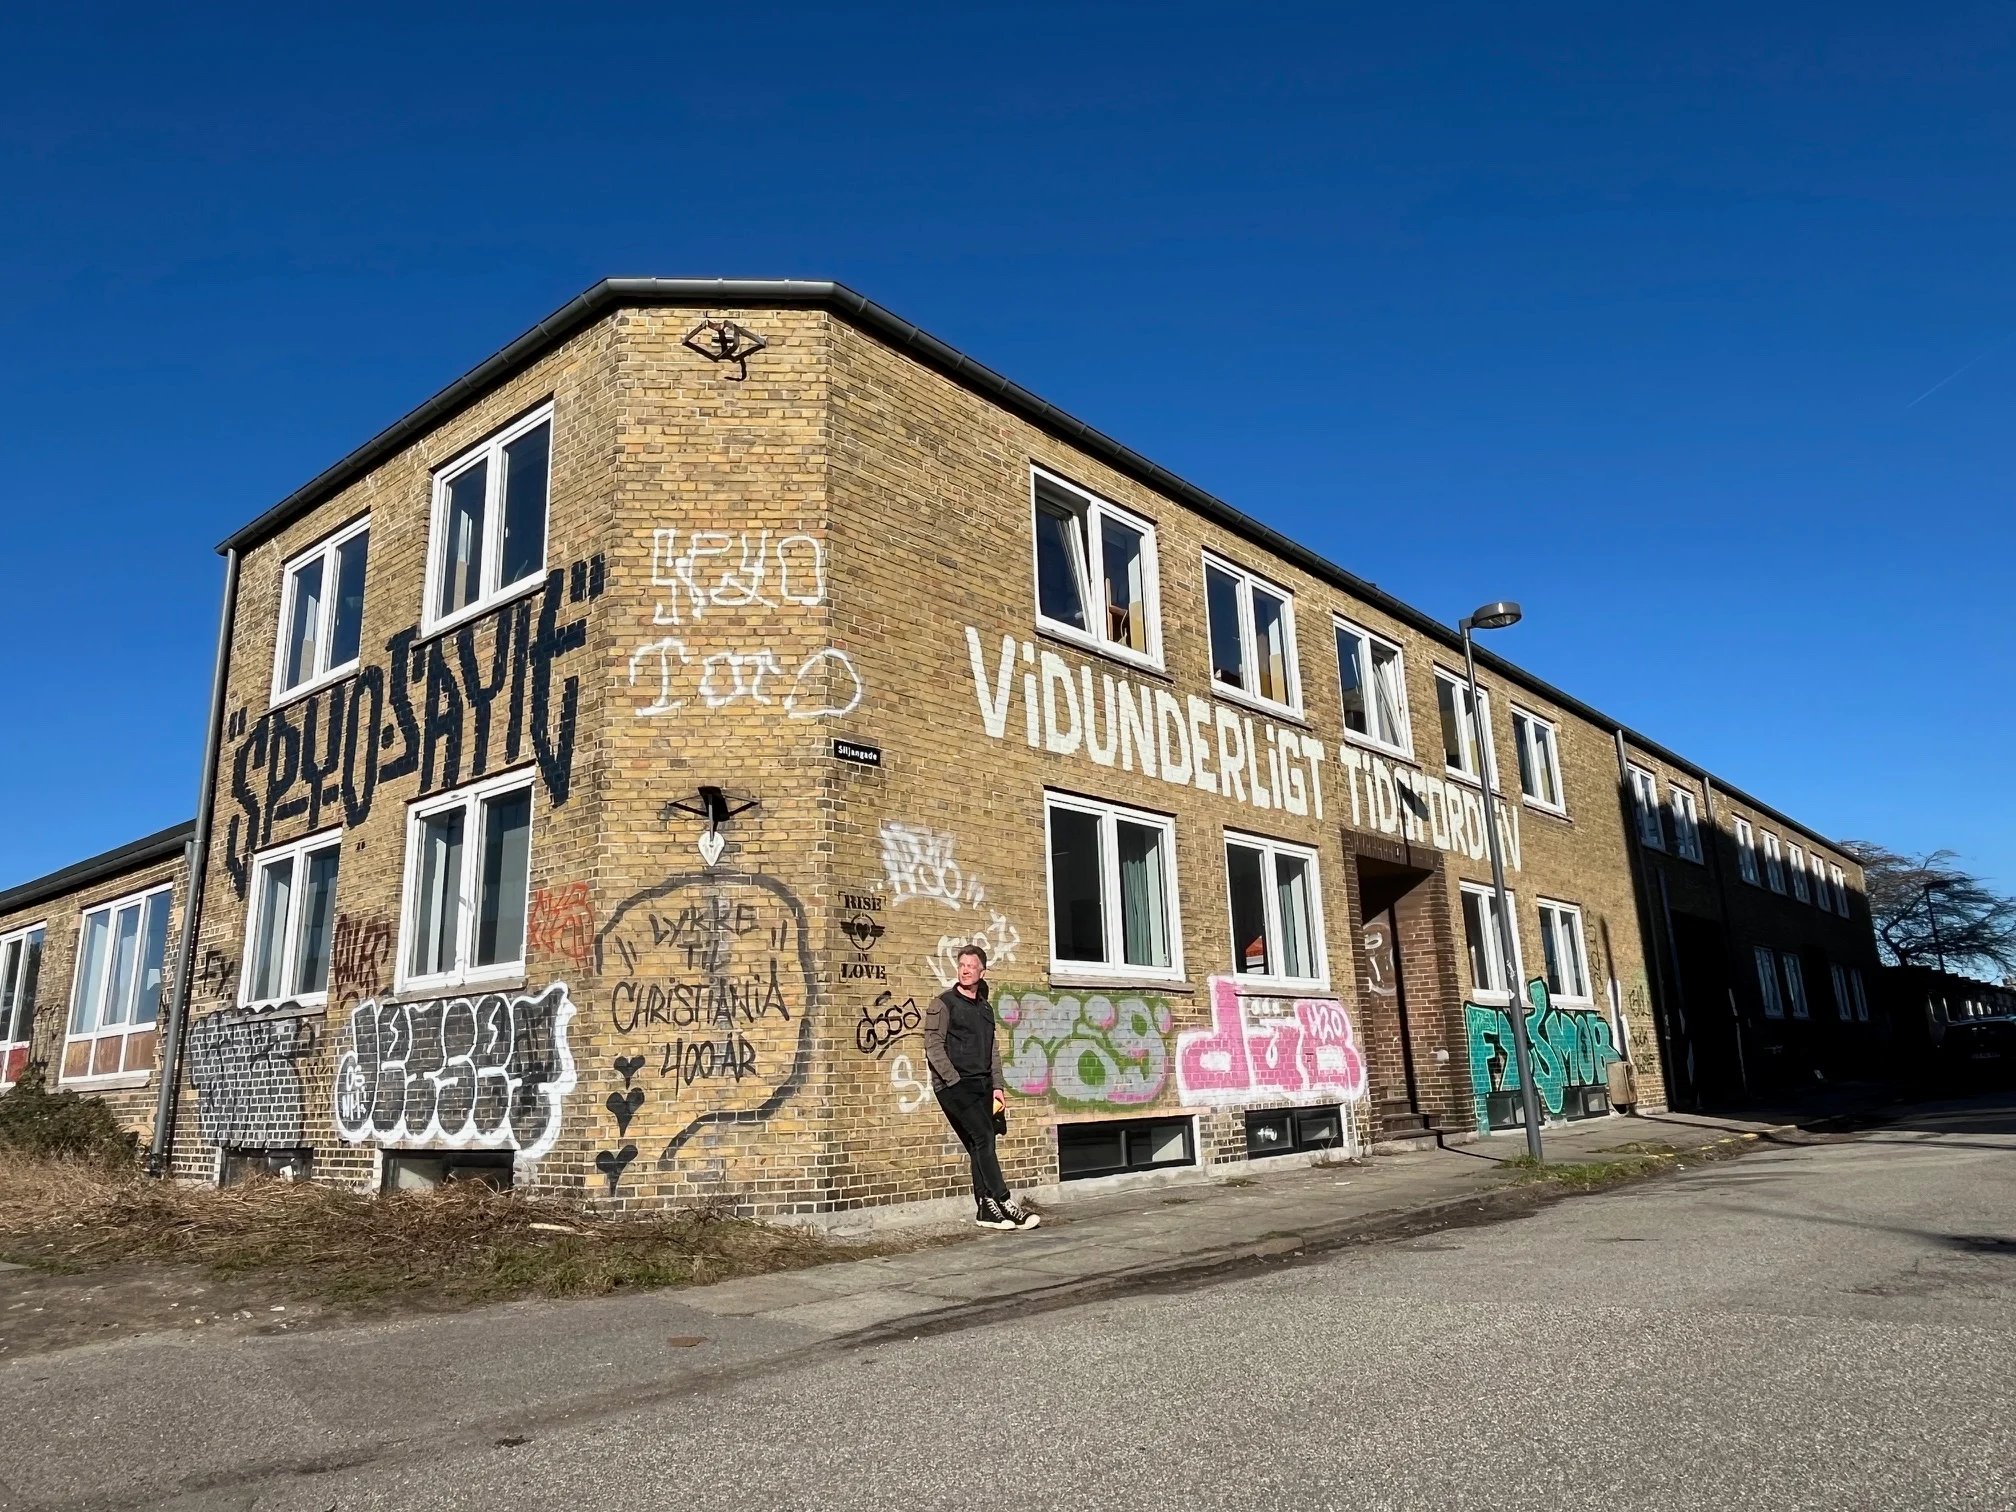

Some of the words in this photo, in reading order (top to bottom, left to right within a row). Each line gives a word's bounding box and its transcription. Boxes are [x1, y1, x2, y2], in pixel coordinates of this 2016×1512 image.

[838, 745, 878, 760] Siljangade
[844, 895, 882, 911] RISE
[649, 897, 759, 947] LYKKE
[858, 953, 868, 962] IN
[841, 963, 886, 979] LOVE
[659, 1038, 715, 1096] 400
